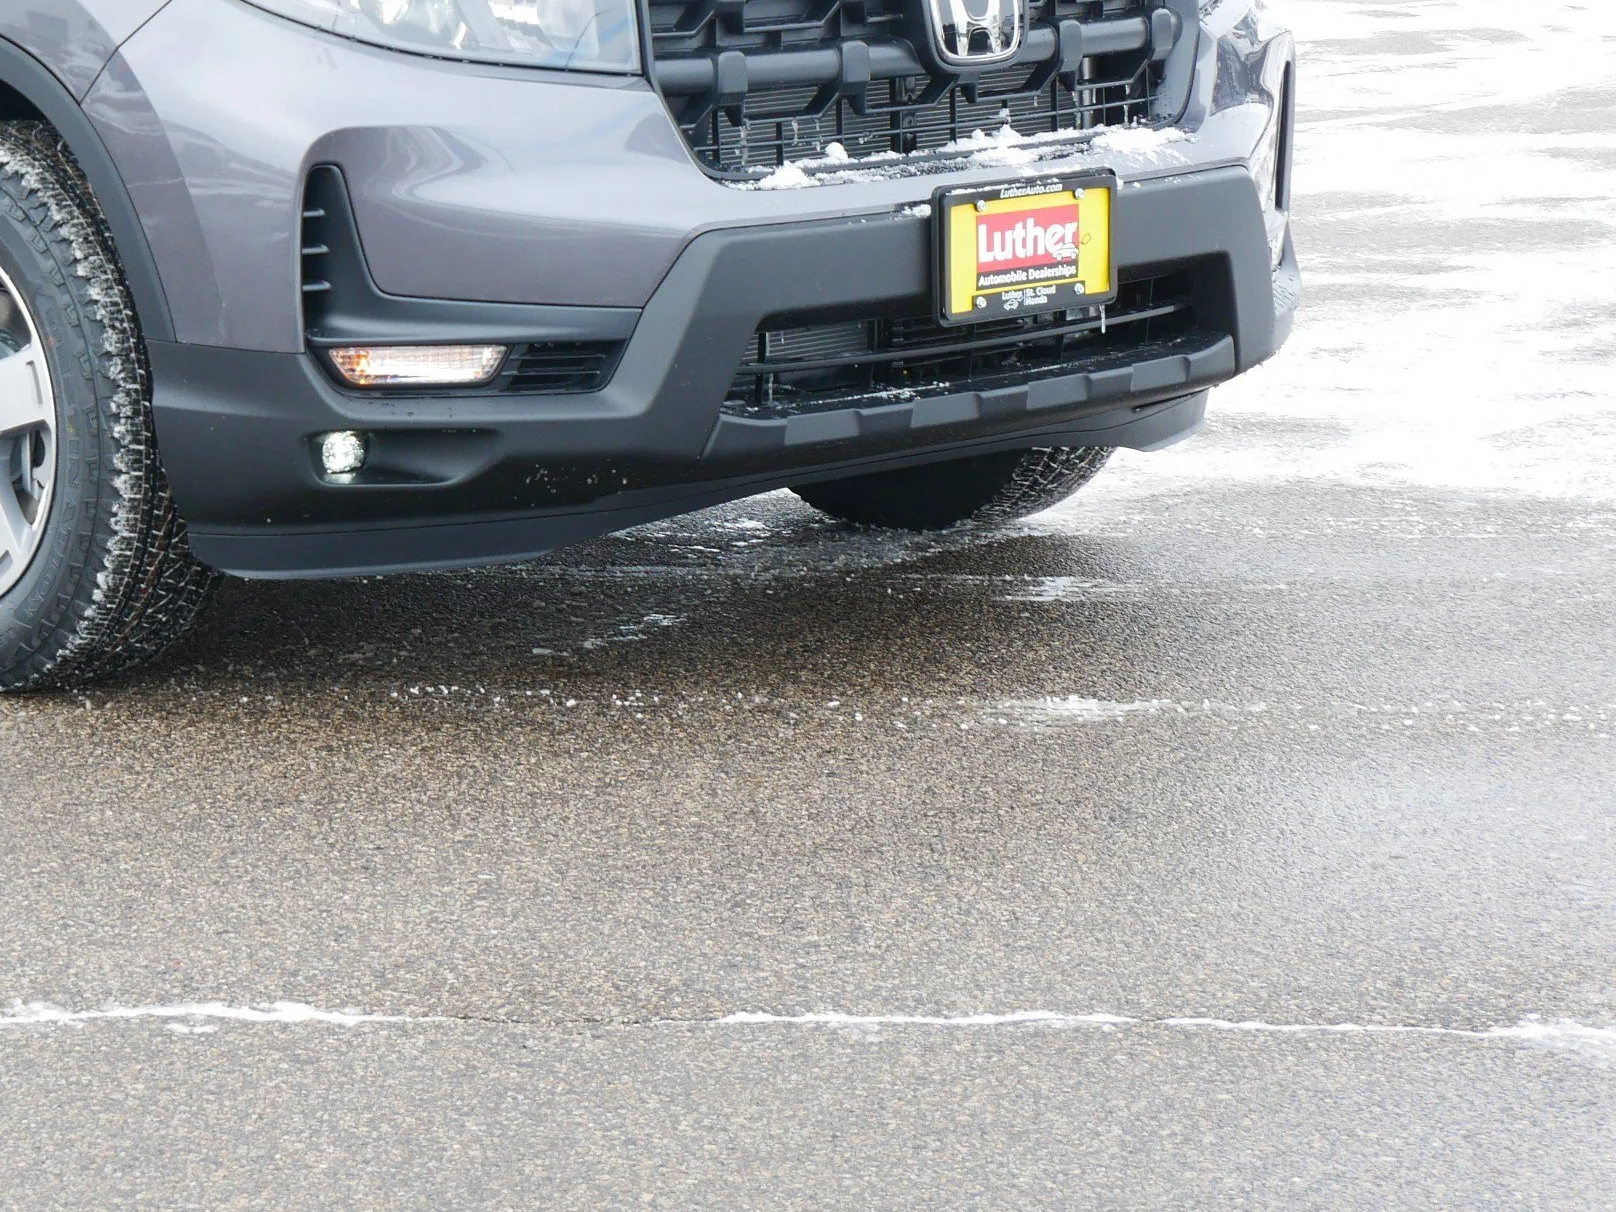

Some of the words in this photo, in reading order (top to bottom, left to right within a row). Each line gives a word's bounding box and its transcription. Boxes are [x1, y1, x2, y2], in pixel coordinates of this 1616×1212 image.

[1000, 184, 1063, 199] LutherAuto.com
[978, 218, 1078, 263] Luther
[978, 269, 1028, 287] Automobile
[1028, 264, 1077, 280] Dealerships
[1036, 285, 1057, 295] Cloud
[1025, 295, 1048, 306] Honda
